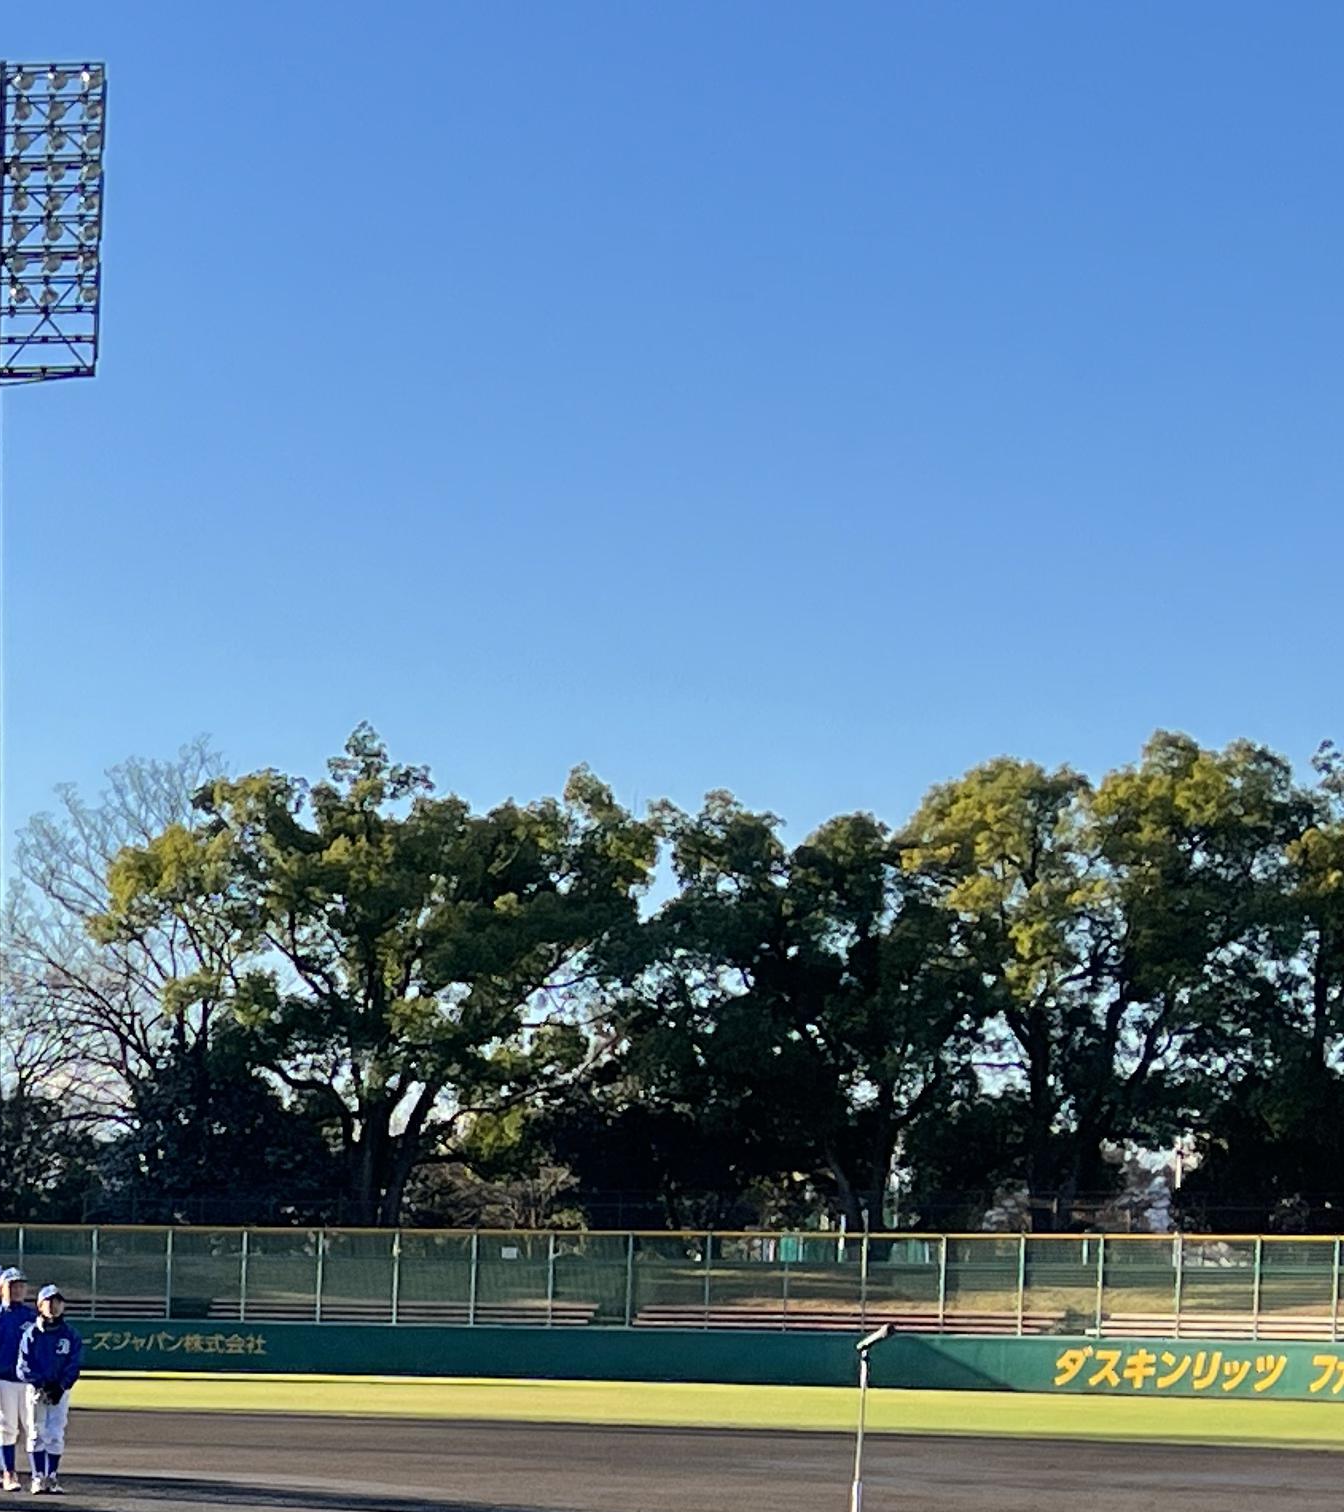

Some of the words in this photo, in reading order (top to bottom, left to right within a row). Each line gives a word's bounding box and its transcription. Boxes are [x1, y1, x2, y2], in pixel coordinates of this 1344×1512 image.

[1053, 1345, 1288, 1393] ダスキンリッツ
